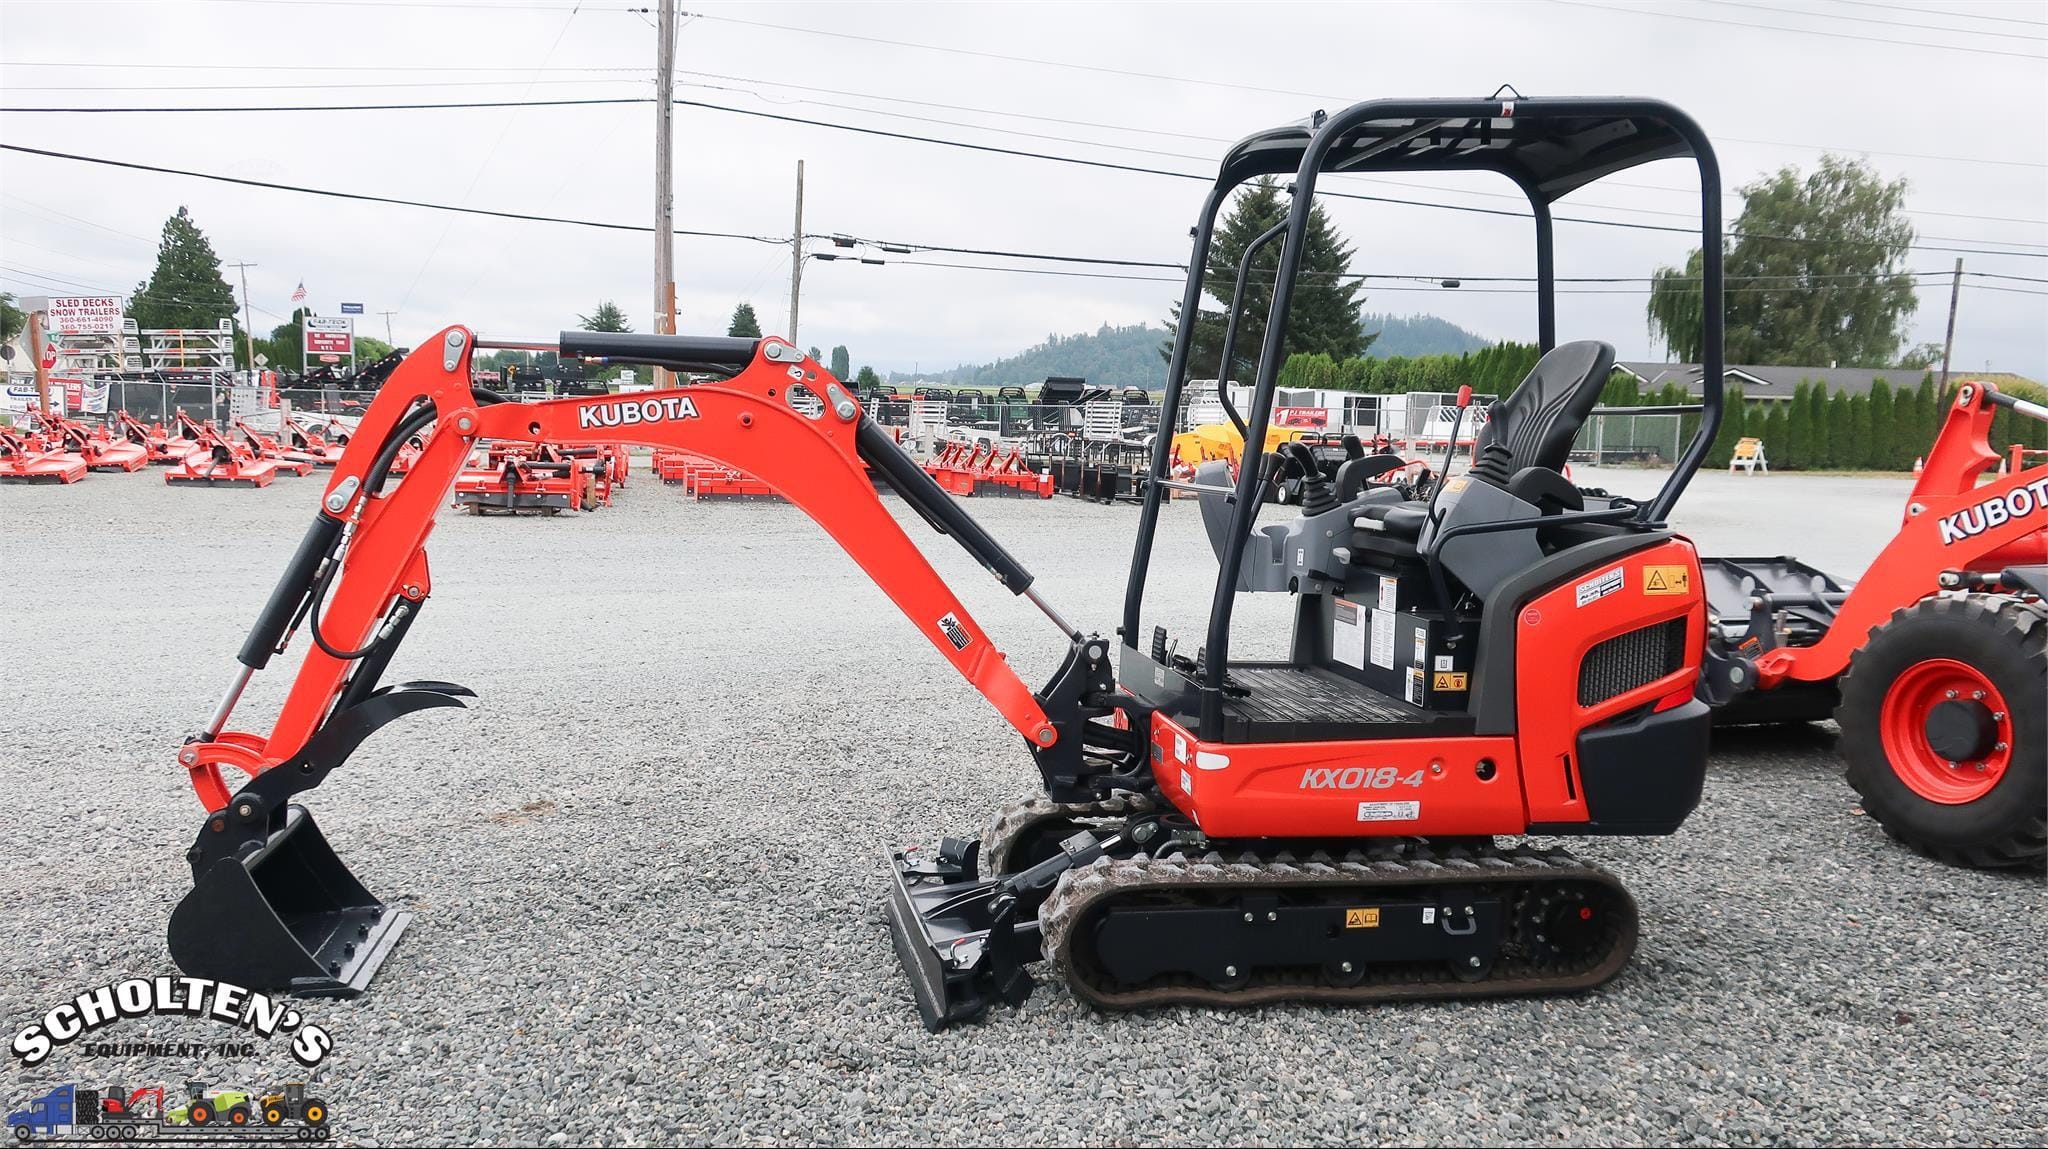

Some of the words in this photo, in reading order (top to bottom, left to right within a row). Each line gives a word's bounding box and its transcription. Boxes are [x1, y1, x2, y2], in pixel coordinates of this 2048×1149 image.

[56, 299, 79, 307] SLED
[82, 298, 114, 307] DECKS
[50, 308, 75, 316] SNOW
[78, 307, 120, 316] TRAILERS
[43, 350, 56, 361] TOP
[578, 396, 700, 429] KUBOTA
[1938, 476, 2048, 546] KUBOT
[1299, 766, 1425, 790] KX018-4
